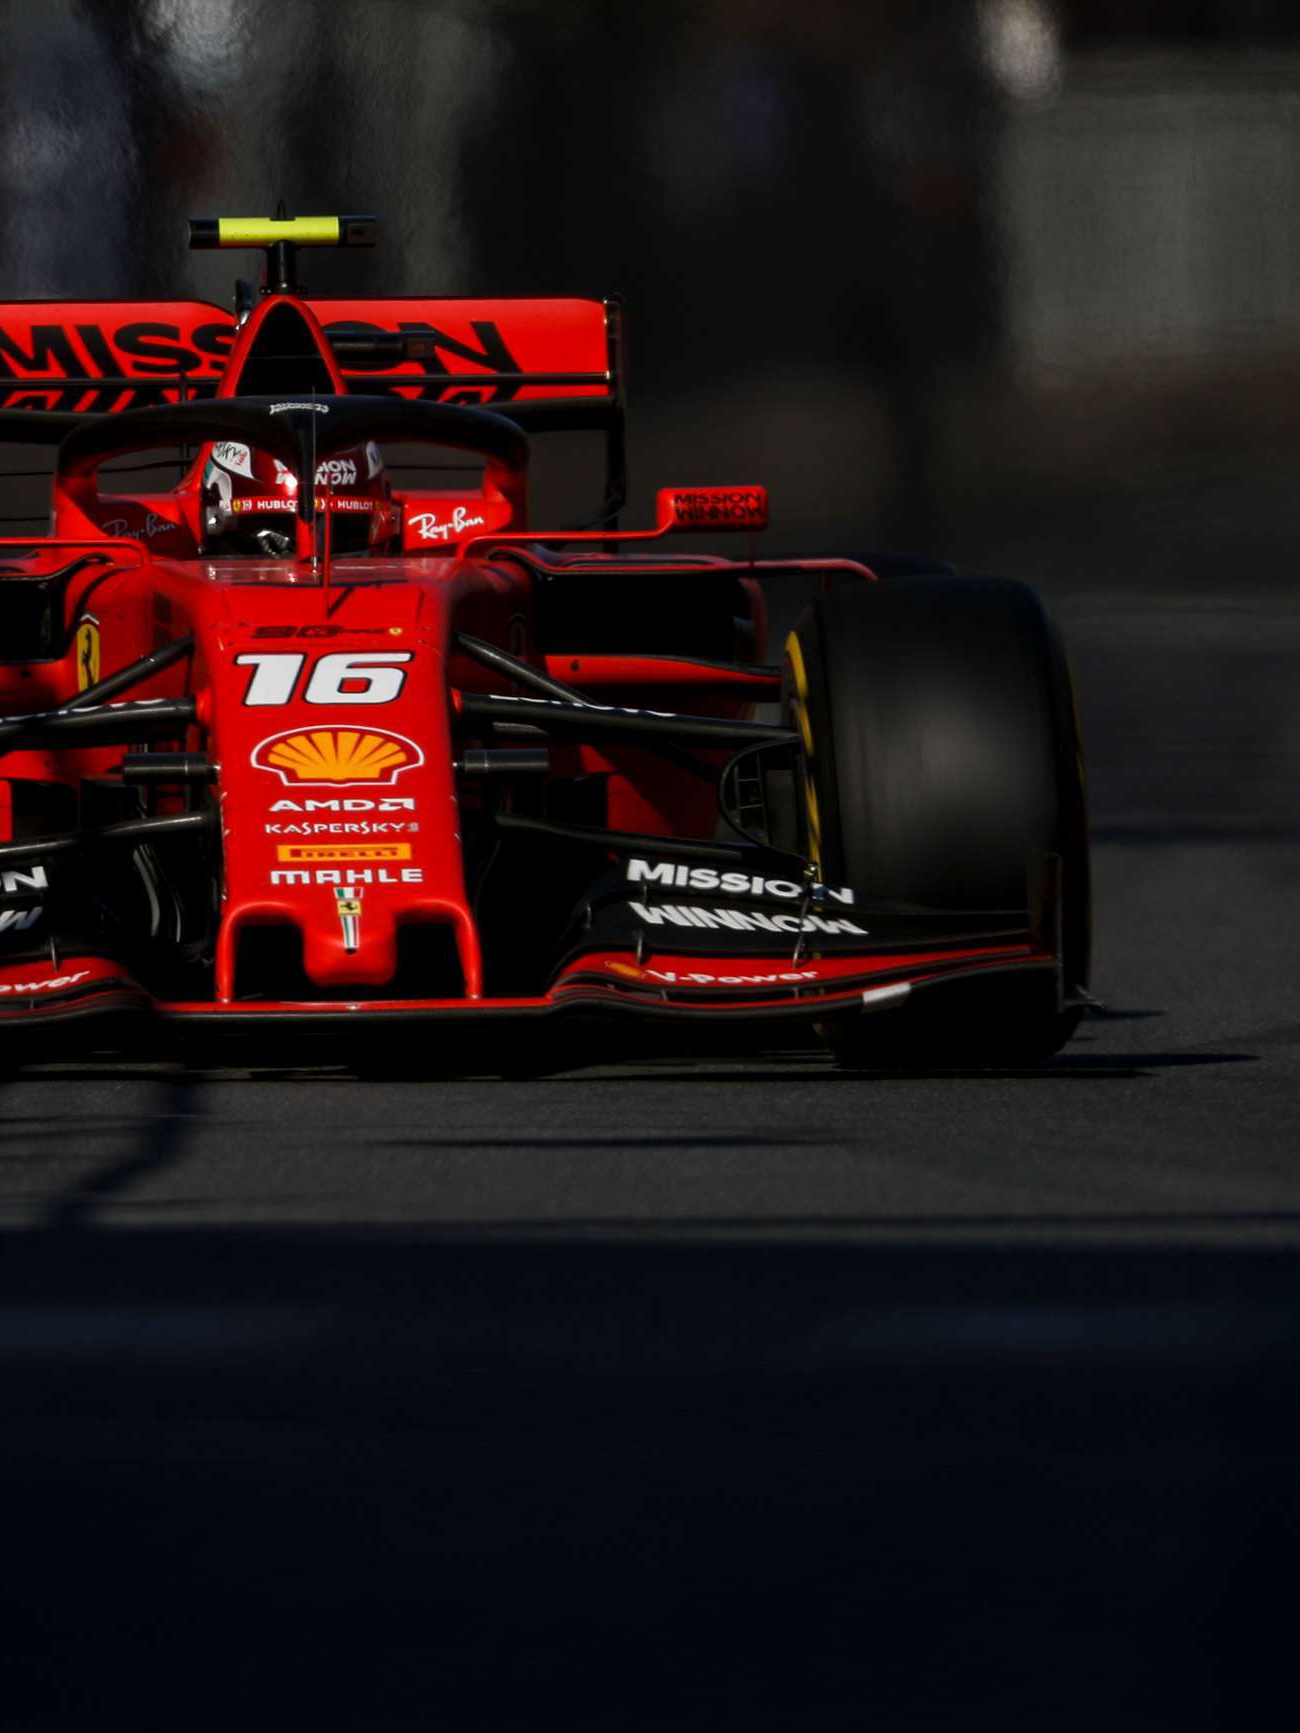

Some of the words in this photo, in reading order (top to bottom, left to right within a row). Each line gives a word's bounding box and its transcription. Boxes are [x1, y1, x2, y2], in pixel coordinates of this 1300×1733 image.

[407, 506, 484, 540] Ray-Ban
[235, 651, 414, 708] 16
[269, 799, 376, 812] AMD
[265, 821, 405, 835] KASPERSKY
[270, 868, 424, 885] MAHLE
[626, 858, 855, 905] MISSION
[627, 900, 869, 936] WINNOW
